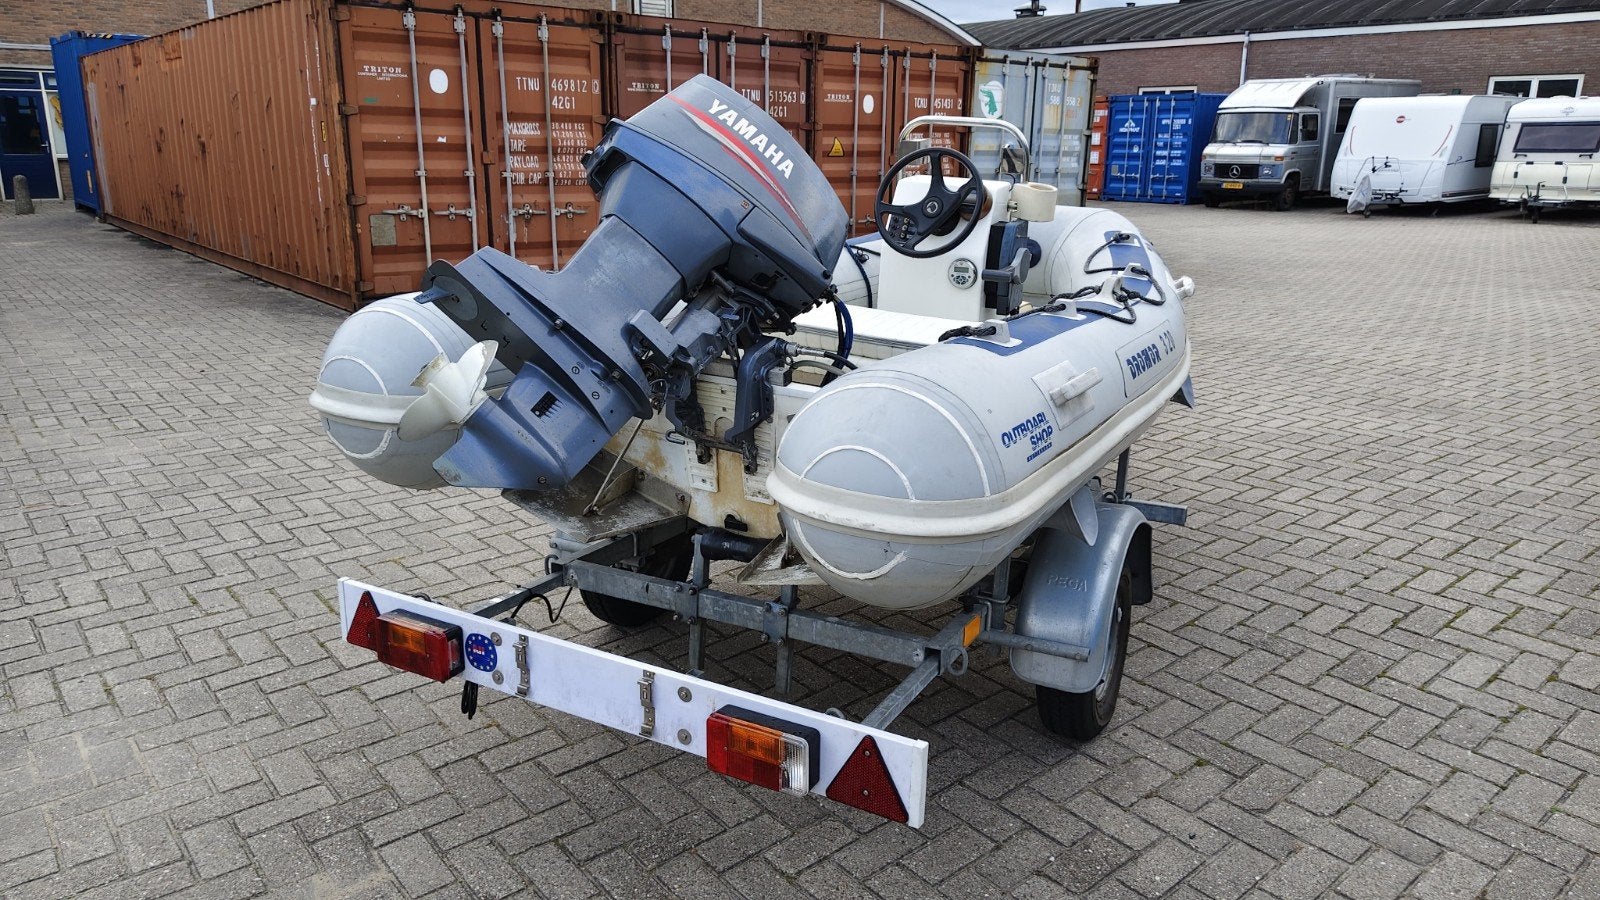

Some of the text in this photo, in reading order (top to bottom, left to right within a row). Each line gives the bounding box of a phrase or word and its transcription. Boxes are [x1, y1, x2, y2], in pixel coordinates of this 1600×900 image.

[363, 65, 402, 74] TRITON
[516, 77, 540, 91] TTNU
[552, 79, 587, 92] 469812
[742, 88, 760, 102] TTNU
[769, 90, 796, 102] 513563
[552, 96, 575, 110] 42G1
[770, 106, 786, 118] 42G1
[708, 98, 795, 180] YAMAHA
[510, 156, 540, 168] PAYLOAD
